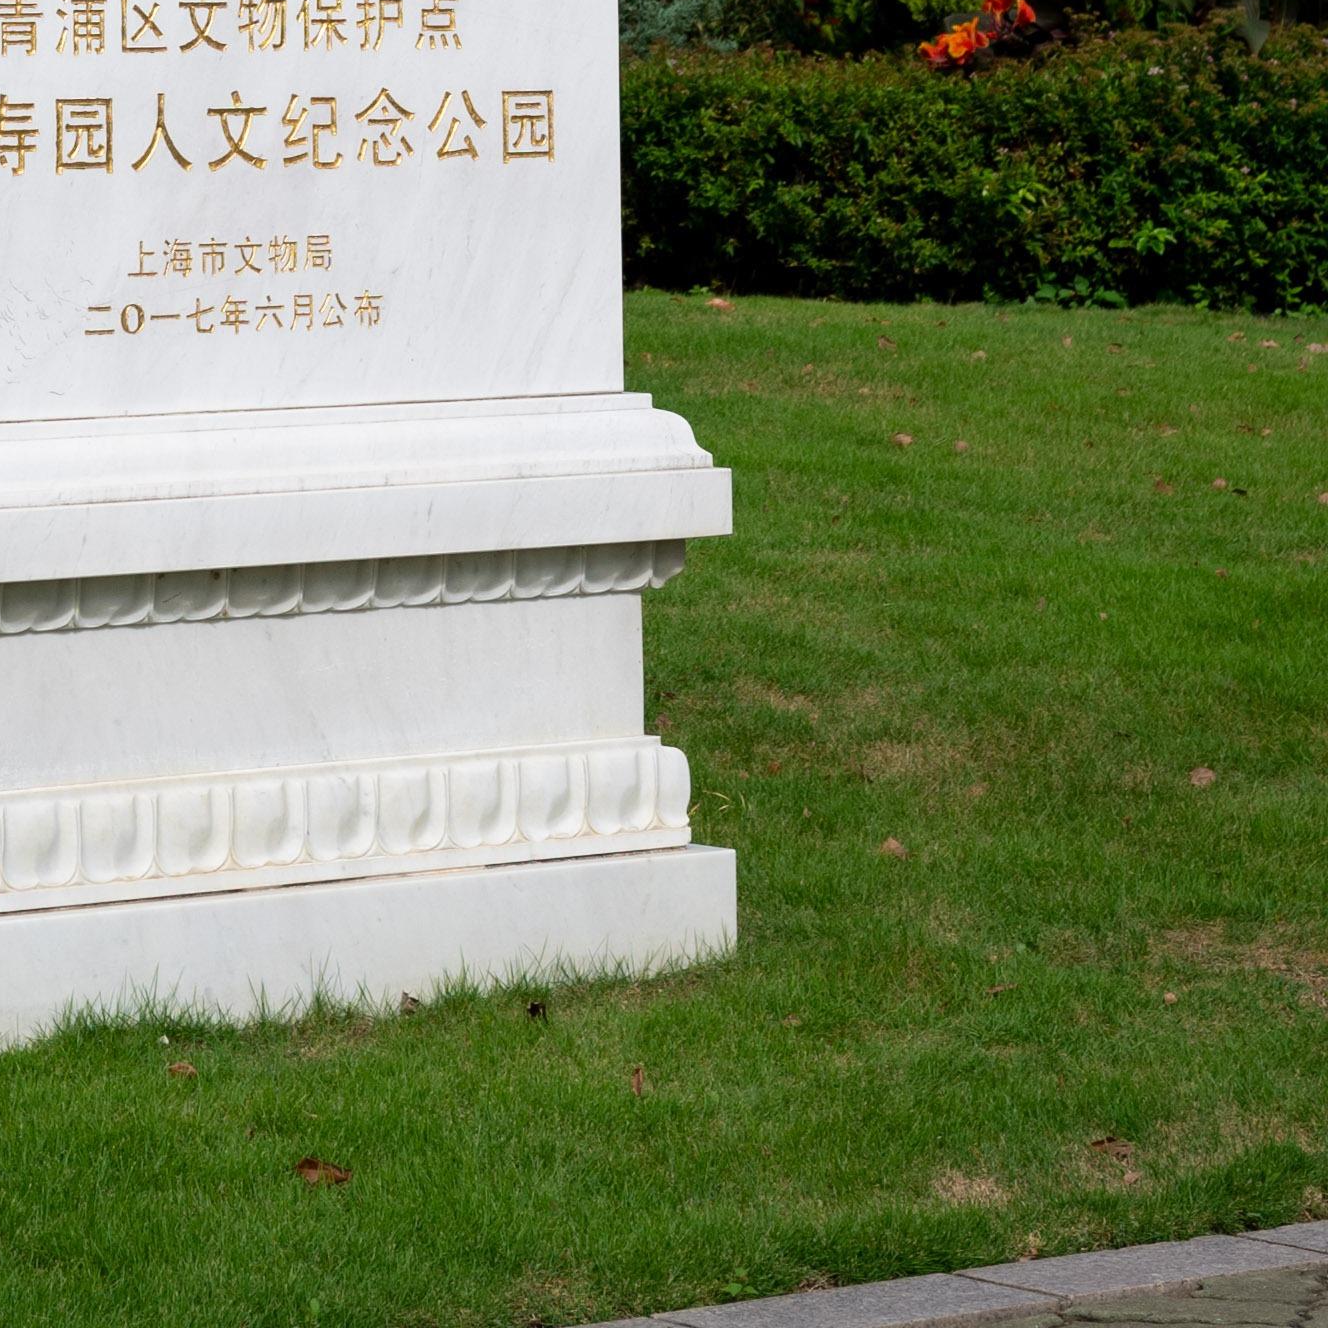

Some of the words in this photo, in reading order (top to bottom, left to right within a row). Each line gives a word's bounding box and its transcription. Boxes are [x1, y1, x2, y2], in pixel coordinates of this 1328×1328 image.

[127, 233, 333, 278] 上海市文物局
